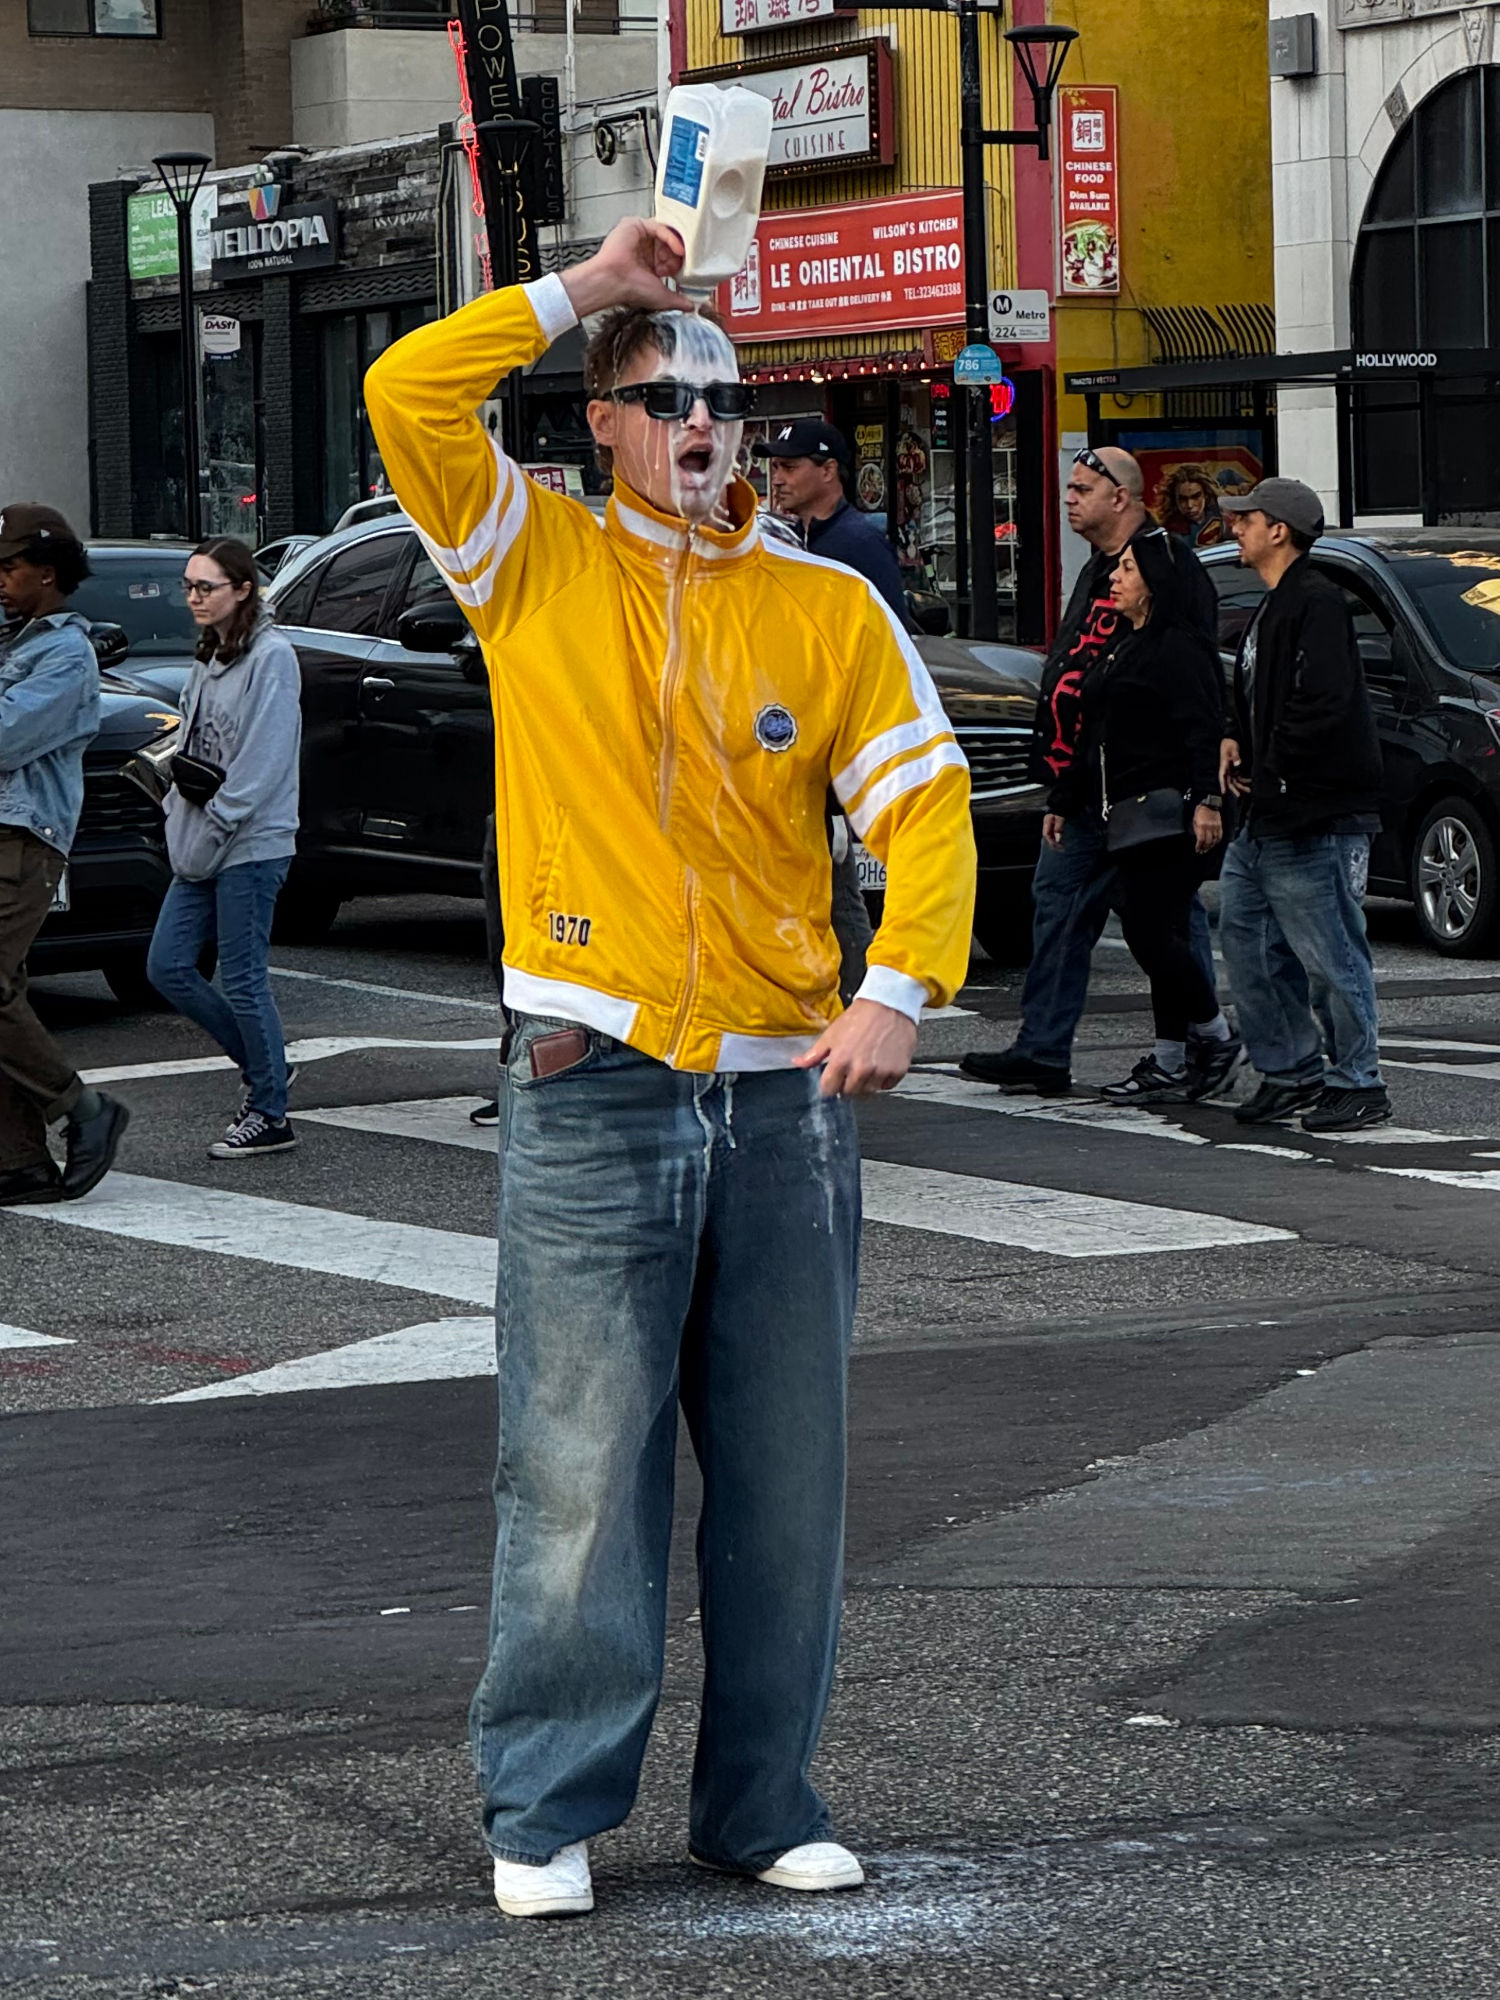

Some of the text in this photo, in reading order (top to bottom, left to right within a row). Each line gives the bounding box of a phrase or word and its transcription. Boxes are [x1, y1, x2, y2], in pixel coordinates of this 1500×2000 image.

[806, 68, 865, 115] Bistro
[541, 82, 560, 213] COCKTAILS
[784, 130, 846, 158] CUISINE
[1066, 162, 1112, 171] CHINESE
[1075, 174, 1104, 183] FOOD
[1069, 191, 1110, 200] Dim Sum
[1069, 202, 1110, 211] AVAILABLE
[209, 215, 330, 259] WELLTOPIA
[872, 217, 958, 240] WILSON'S KITCHEN
[769, 231, 839, 251] CHINESE CUISINE
[770, 262, 791, 288] LE
[799, 252, 885, 286] ORIENTAL
[893, 243, 961, 276] BISTRO
[1016, 310, 1046, 319] Metro
[995, 327, 1017, 338] 224
[958, 359, 980, 370] 786
[1356, 353, 1438, 367] HOLLYWOOD
[549, 911, 591, 947] 1970
